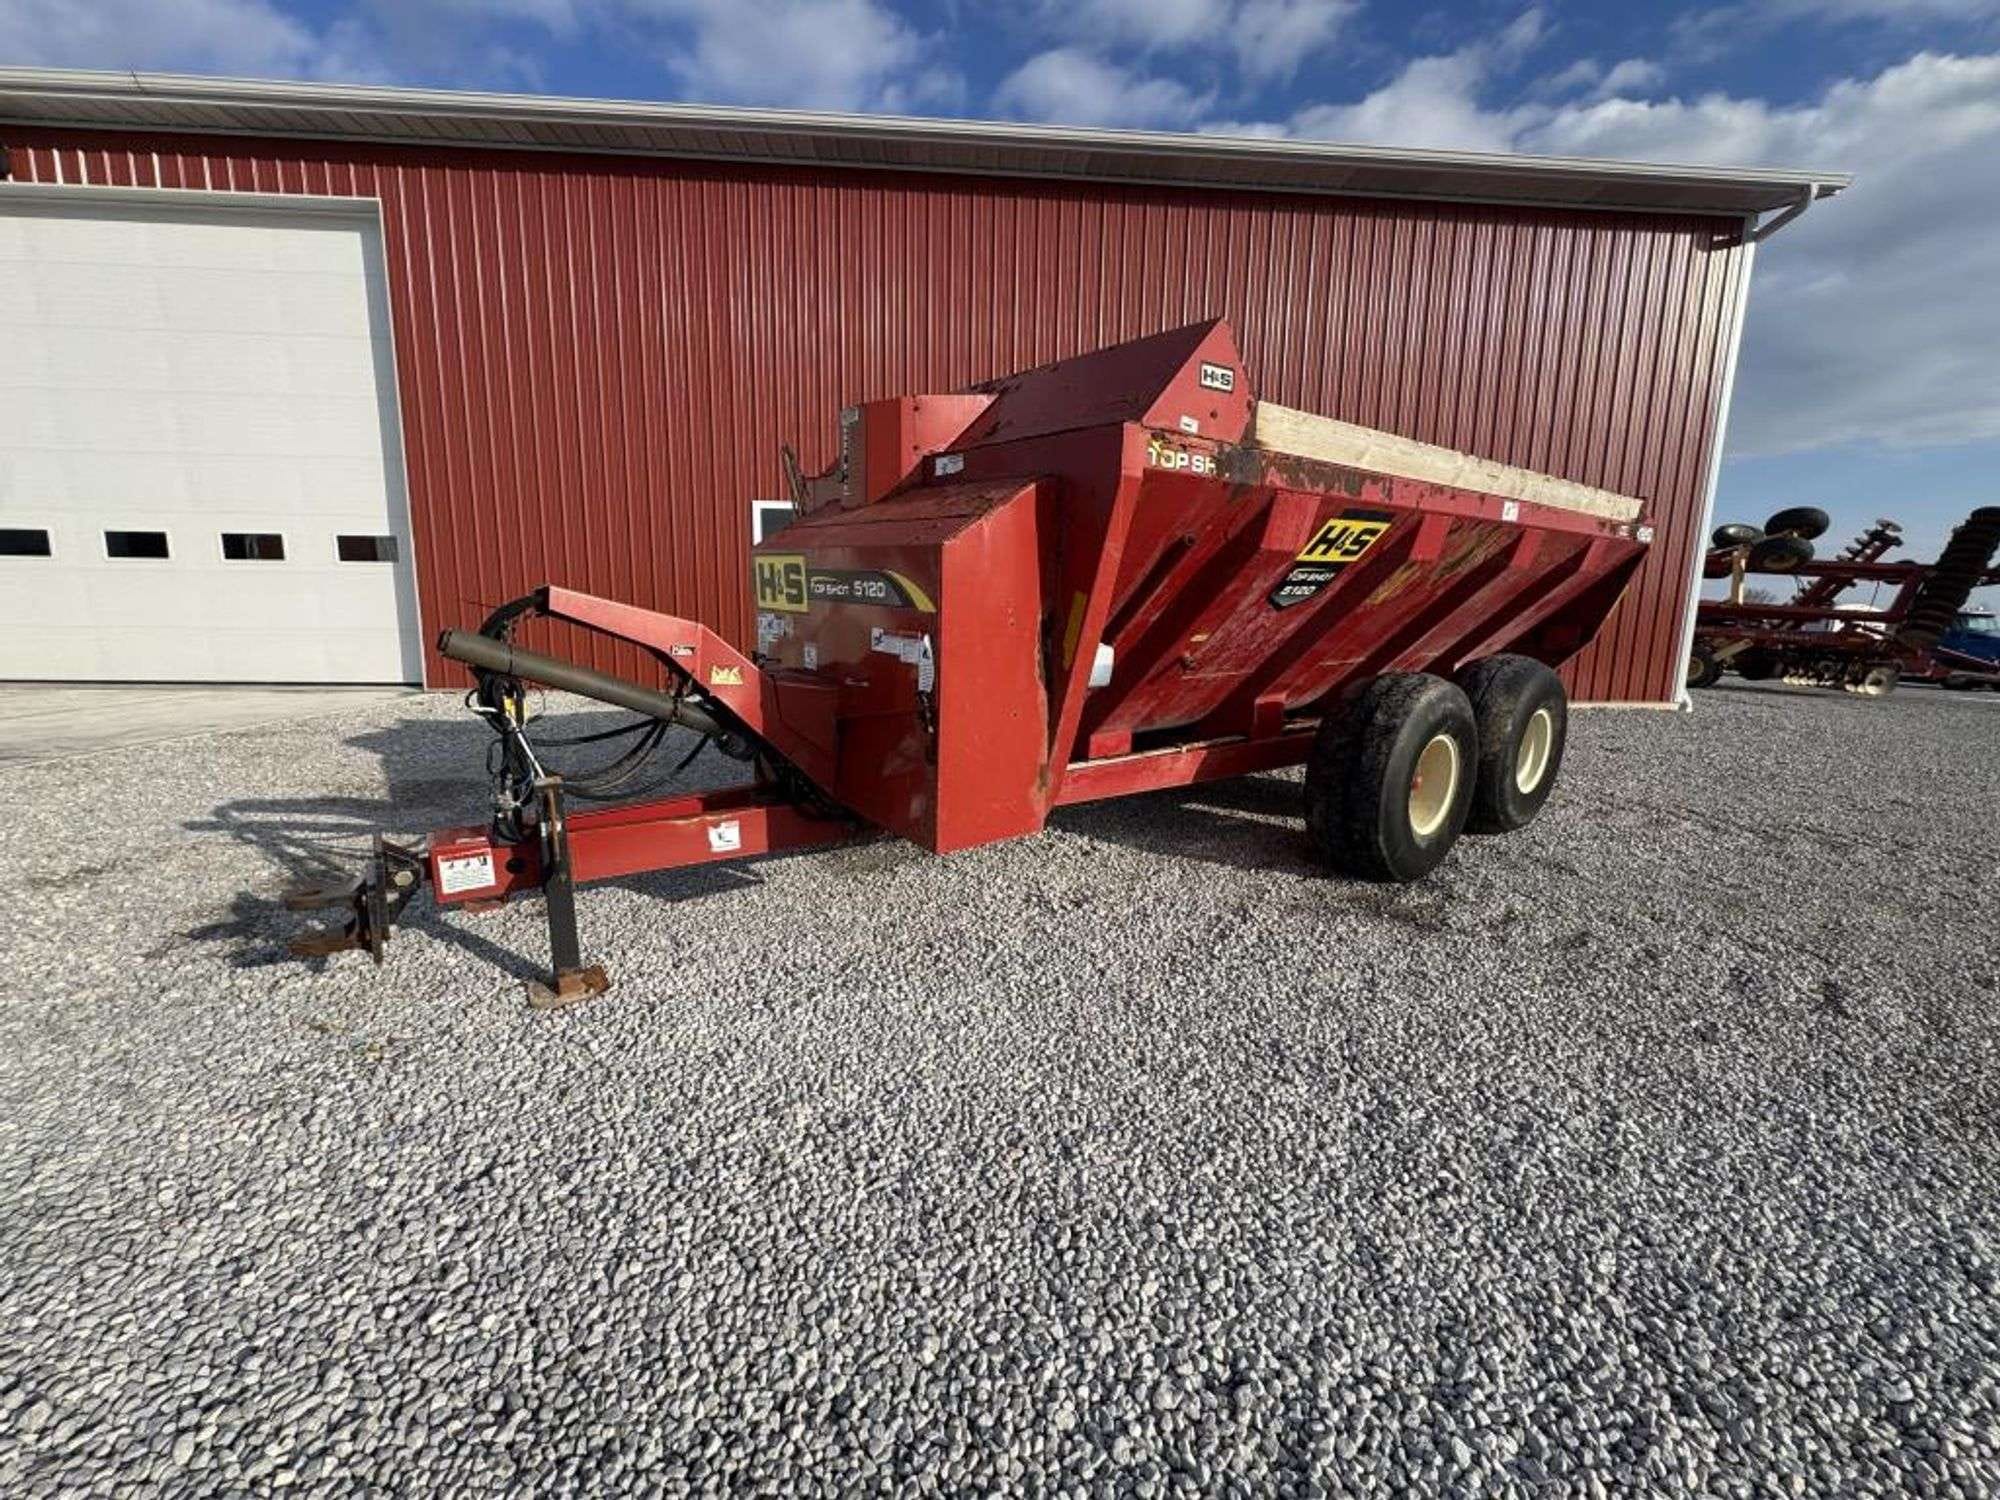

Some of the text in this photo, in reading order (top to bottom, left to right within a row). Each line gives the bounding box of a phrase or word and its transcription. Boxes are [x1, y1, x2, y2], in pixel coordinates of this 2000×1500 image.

[1203, 368, 1232, 387] H&S
[1148, 446, 1217, 475] TOP SH
[1303, 525, 1382, 556] H&S
[758, 562, 804, 604] H&S
[853, 580, 886, 597] 5120
